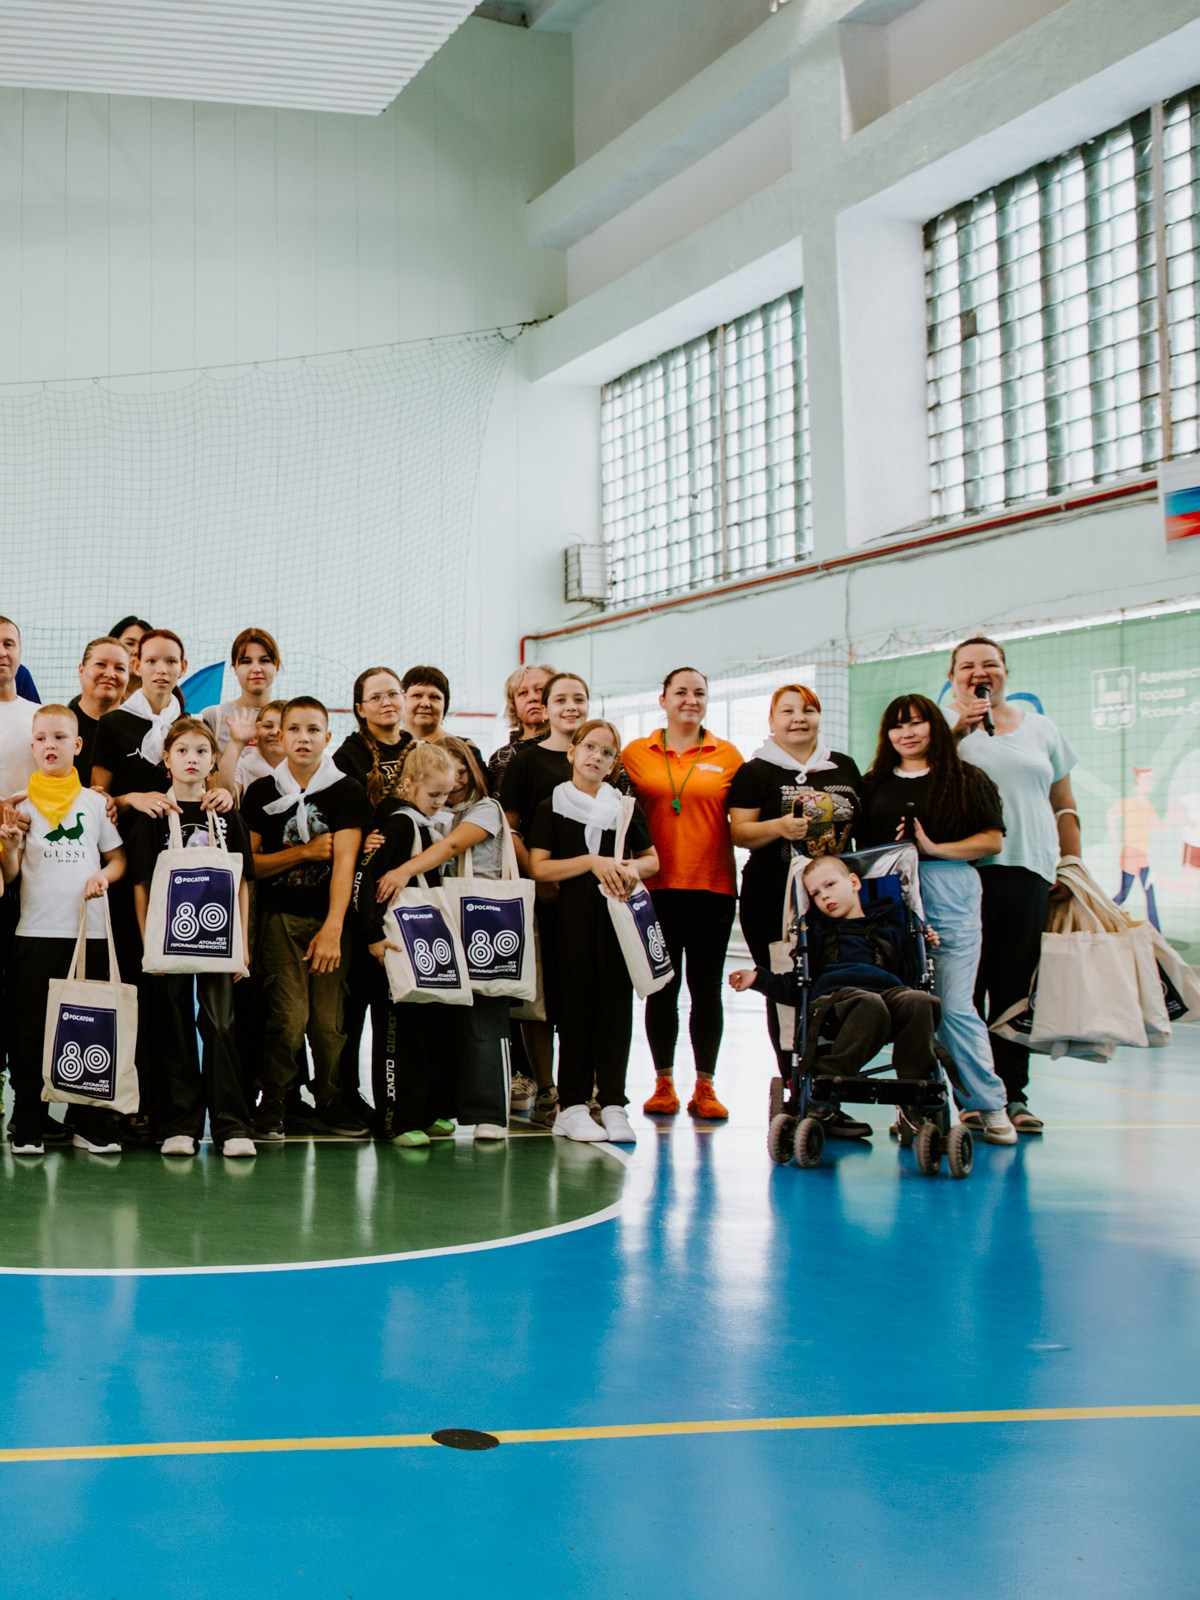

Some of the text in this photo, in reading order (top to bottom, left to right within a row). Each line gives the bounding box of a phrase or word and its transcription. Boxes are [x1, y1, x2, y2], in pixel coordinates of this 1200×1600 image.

[1139, 687, 1186, 702] города
[43, 850, 85, 859] GUSSI
[474, 904, 501, 912] РОСАТОМ
[171, 902, 228, 941] 80
[170, 942, 227, 950] ПРОМЫШЛЕННОСТИ
[467, 929, 520, 967] 80
[413, 937, 452, 976] 80
[69, 1014, 95, 1022] РОСАТОМ
[57, 1041, 111, 1082] 80
